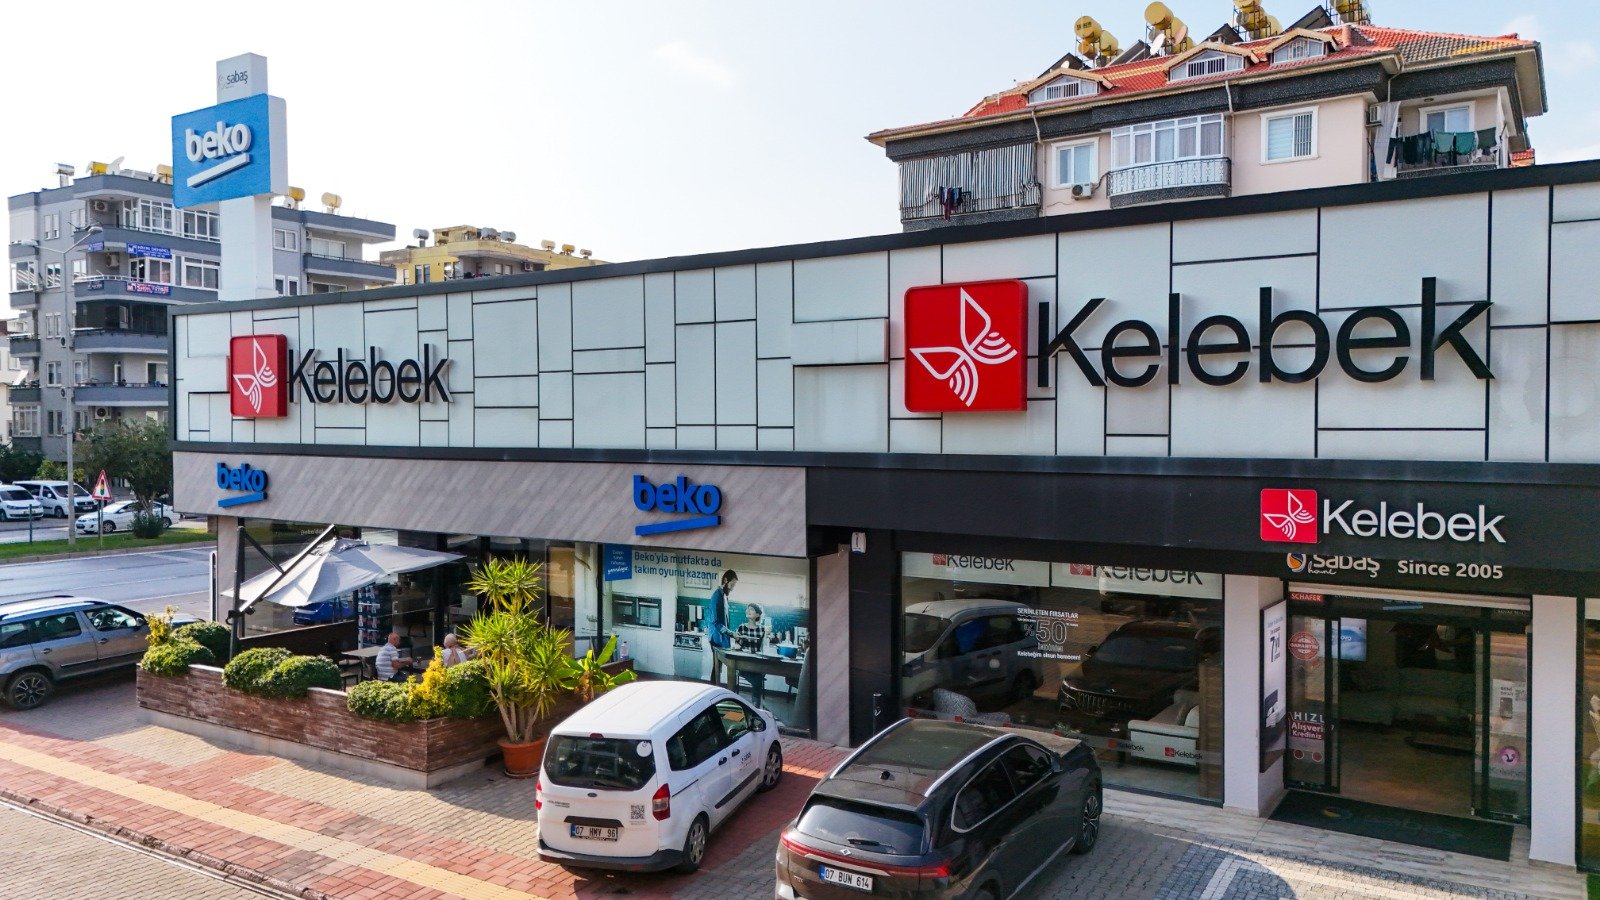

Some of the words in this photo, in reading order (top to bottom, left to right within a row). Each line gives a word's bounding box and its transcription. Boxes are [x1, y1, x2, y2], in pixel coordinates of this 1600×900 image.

[226, 70, 249, 85] sabaş
[185, 120, 252, 163] beko
[1037, 276, 1495, 388] Kelebek
[288, 343, 454, 404] Kelebek
[216, 462, 268, 492] beko
[632, 474, 722, 515] beko
[1322, 498, 1507, 544] Kelebek
[670, 555, 710, 566] mutfakta
[711, 557, 722, 567] da
[1397, 559, 1450, 576] Since
[1455, 562, 1504, 579] 2005
[634, 565, 658, 575] takım
[658, 567, 685, 578] oyunu
[686, 570, 718, 580] kazanır
[1294, 711, 1325, 723] HIZL
[1291, 722, 1325, 733] Alışveri
[575, 826, 584, 836] 07
[589, 828, 602, 837] HMY
[607, 829, 616, 838] 96
[825, 869, 834, 880] 07
[838, 872, 852, 884] BUN
[856, 876, 869, 888] 614
